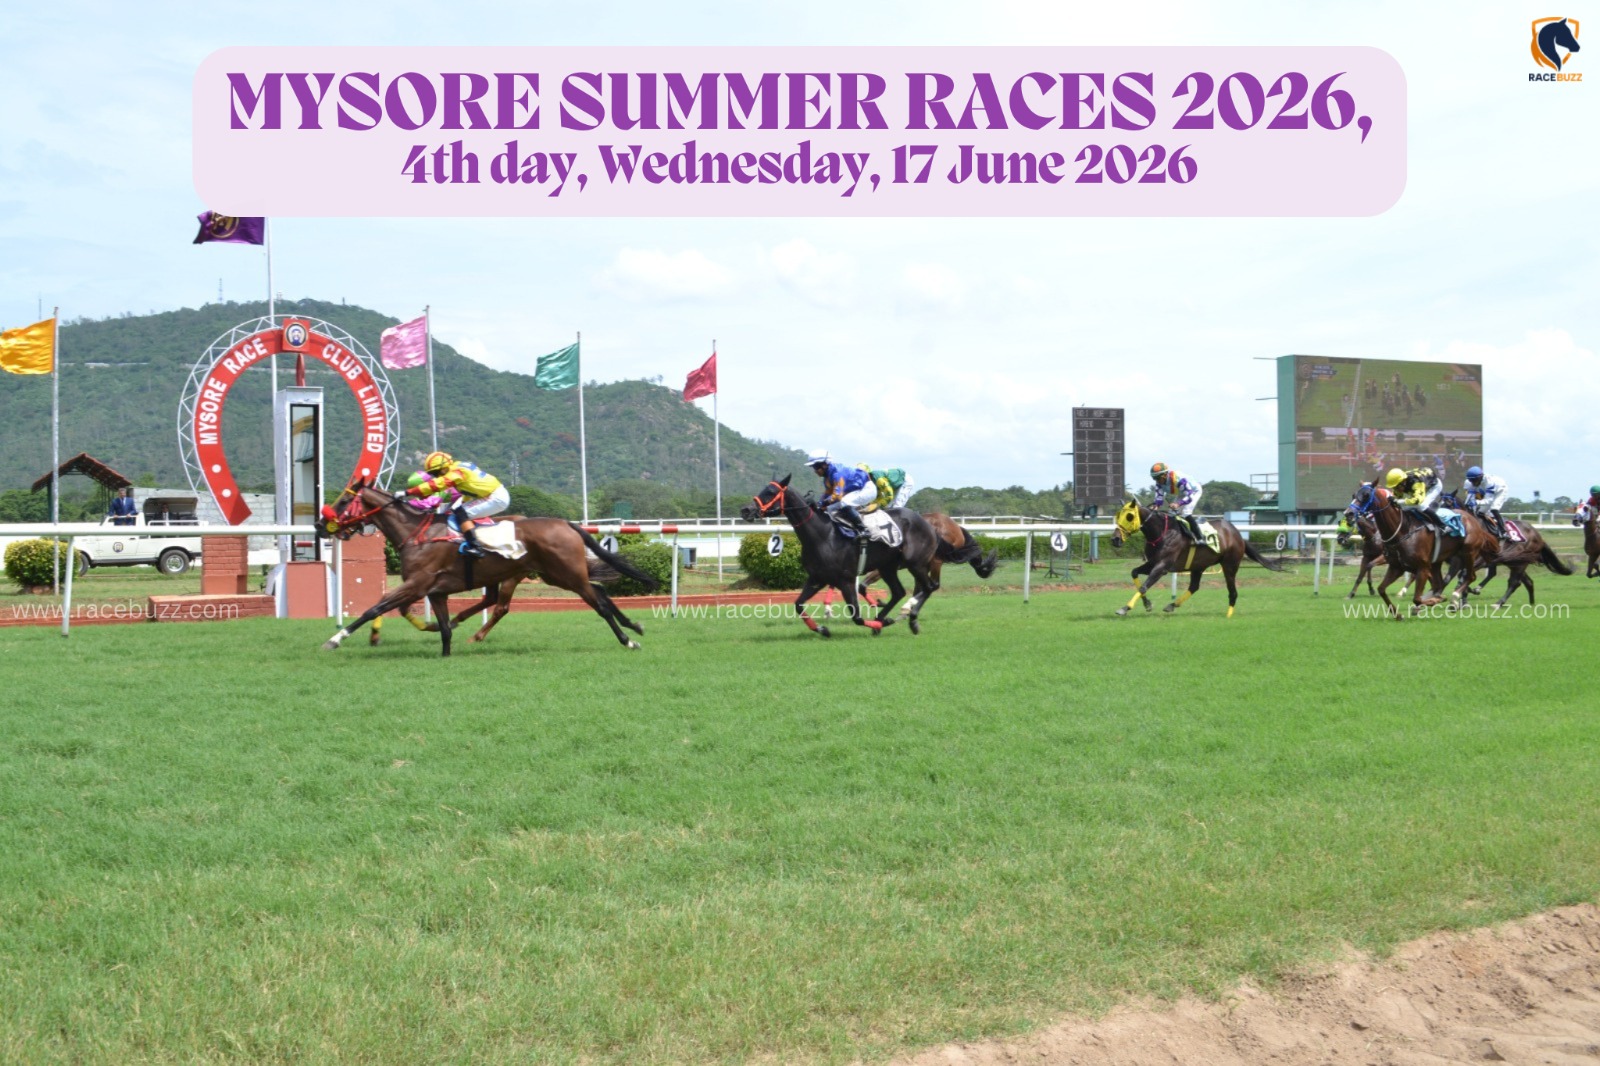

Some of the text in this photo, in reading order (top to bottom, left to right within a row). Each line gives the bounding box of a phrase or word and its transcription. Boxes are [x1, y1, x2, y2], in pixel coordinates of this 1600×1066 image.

[198, 337, 384, 454] MYSORE RACE CLUB LIMITED
[878, 522, 898, 545] 7
[1053, 534, 1064, 550] 4
[1276, 534, 1286, 549] 6
[603, 537, 612, 552] 1
[770, 535, 781, 554] 2
